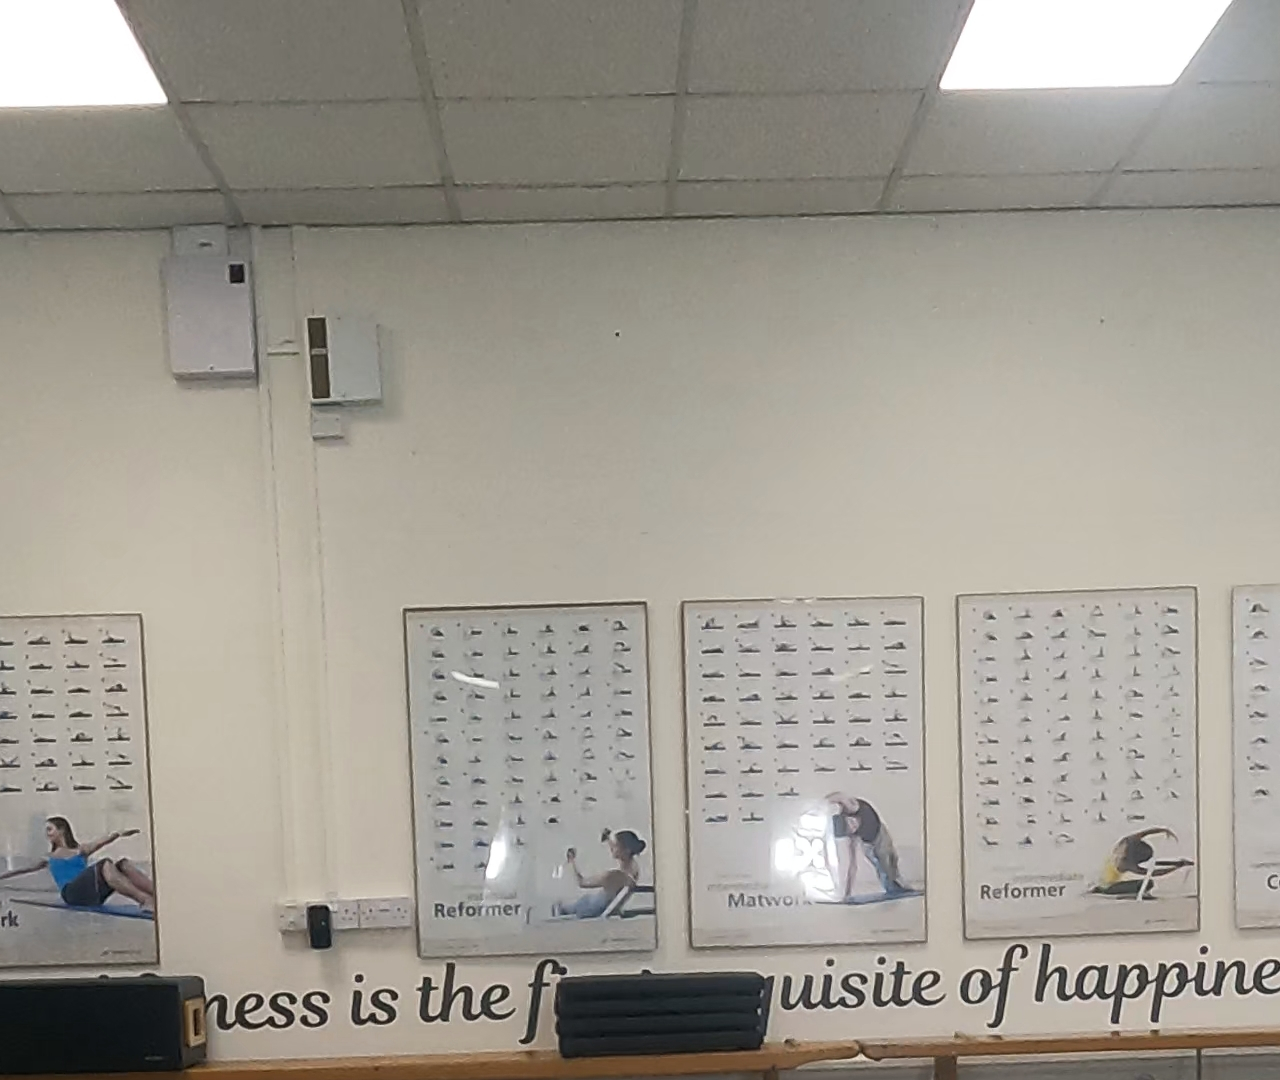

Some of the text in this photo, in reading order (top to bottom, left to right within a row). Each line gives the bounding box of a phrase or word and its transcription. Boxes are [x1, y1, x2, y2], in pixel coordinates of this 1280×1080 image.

[980, 883, 1066, 900] Reformer
[433, 902, 521, 919] Reformer
[205, 990, 331, 1031] ness
[350, 973, 399, 1026] is
[415, 962, 516, 1024] the
[959, 943, 1029, 1029] of
